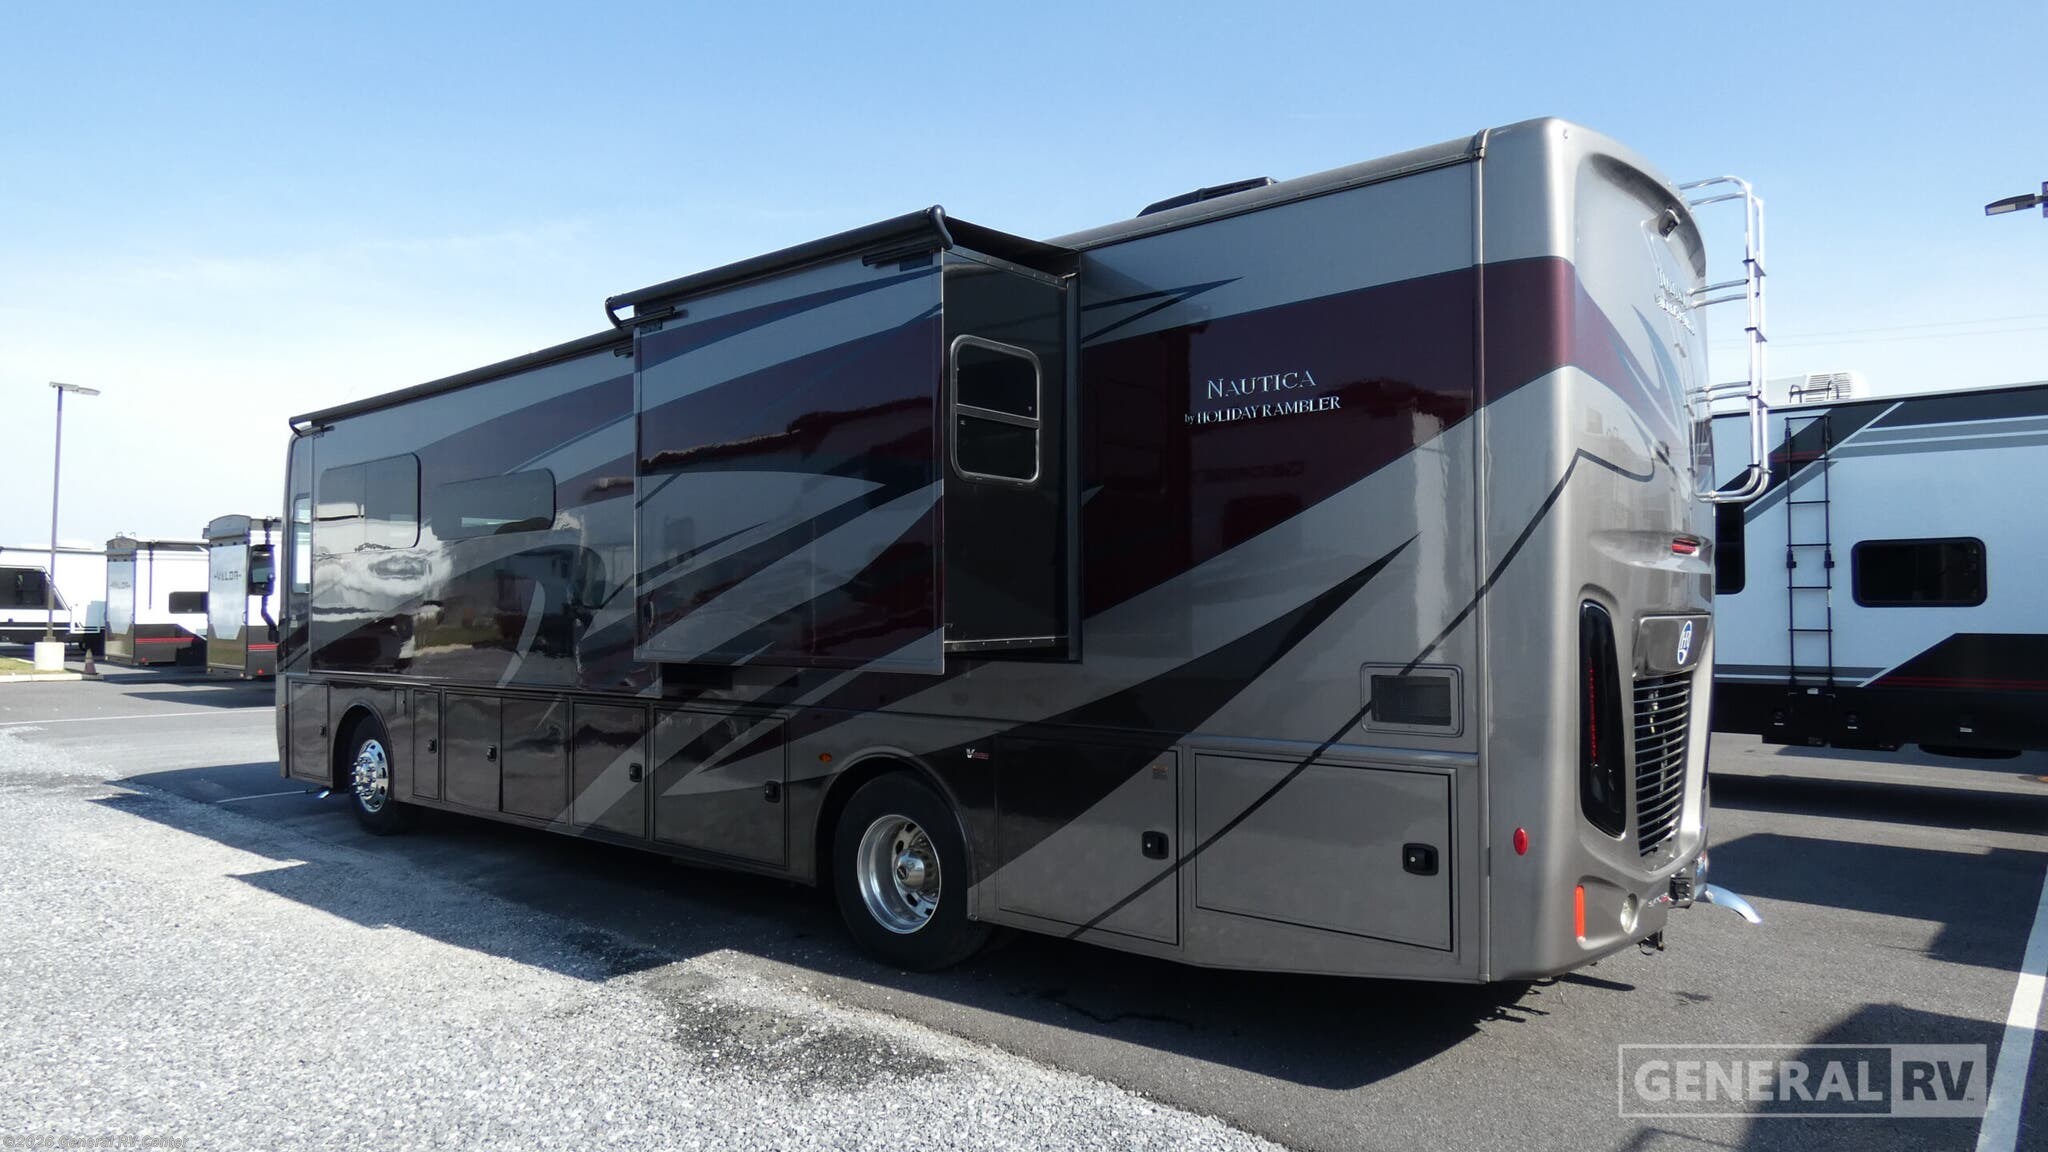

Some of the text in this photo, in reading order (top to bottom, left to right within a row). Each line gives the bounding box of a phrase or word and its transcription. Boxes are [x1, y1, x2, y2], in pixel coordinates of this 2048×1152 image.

[1207, 370, 1316, 399] NAUTICA
[1184, 395, 1341, 425] by HOLIDAY RAMBLER
